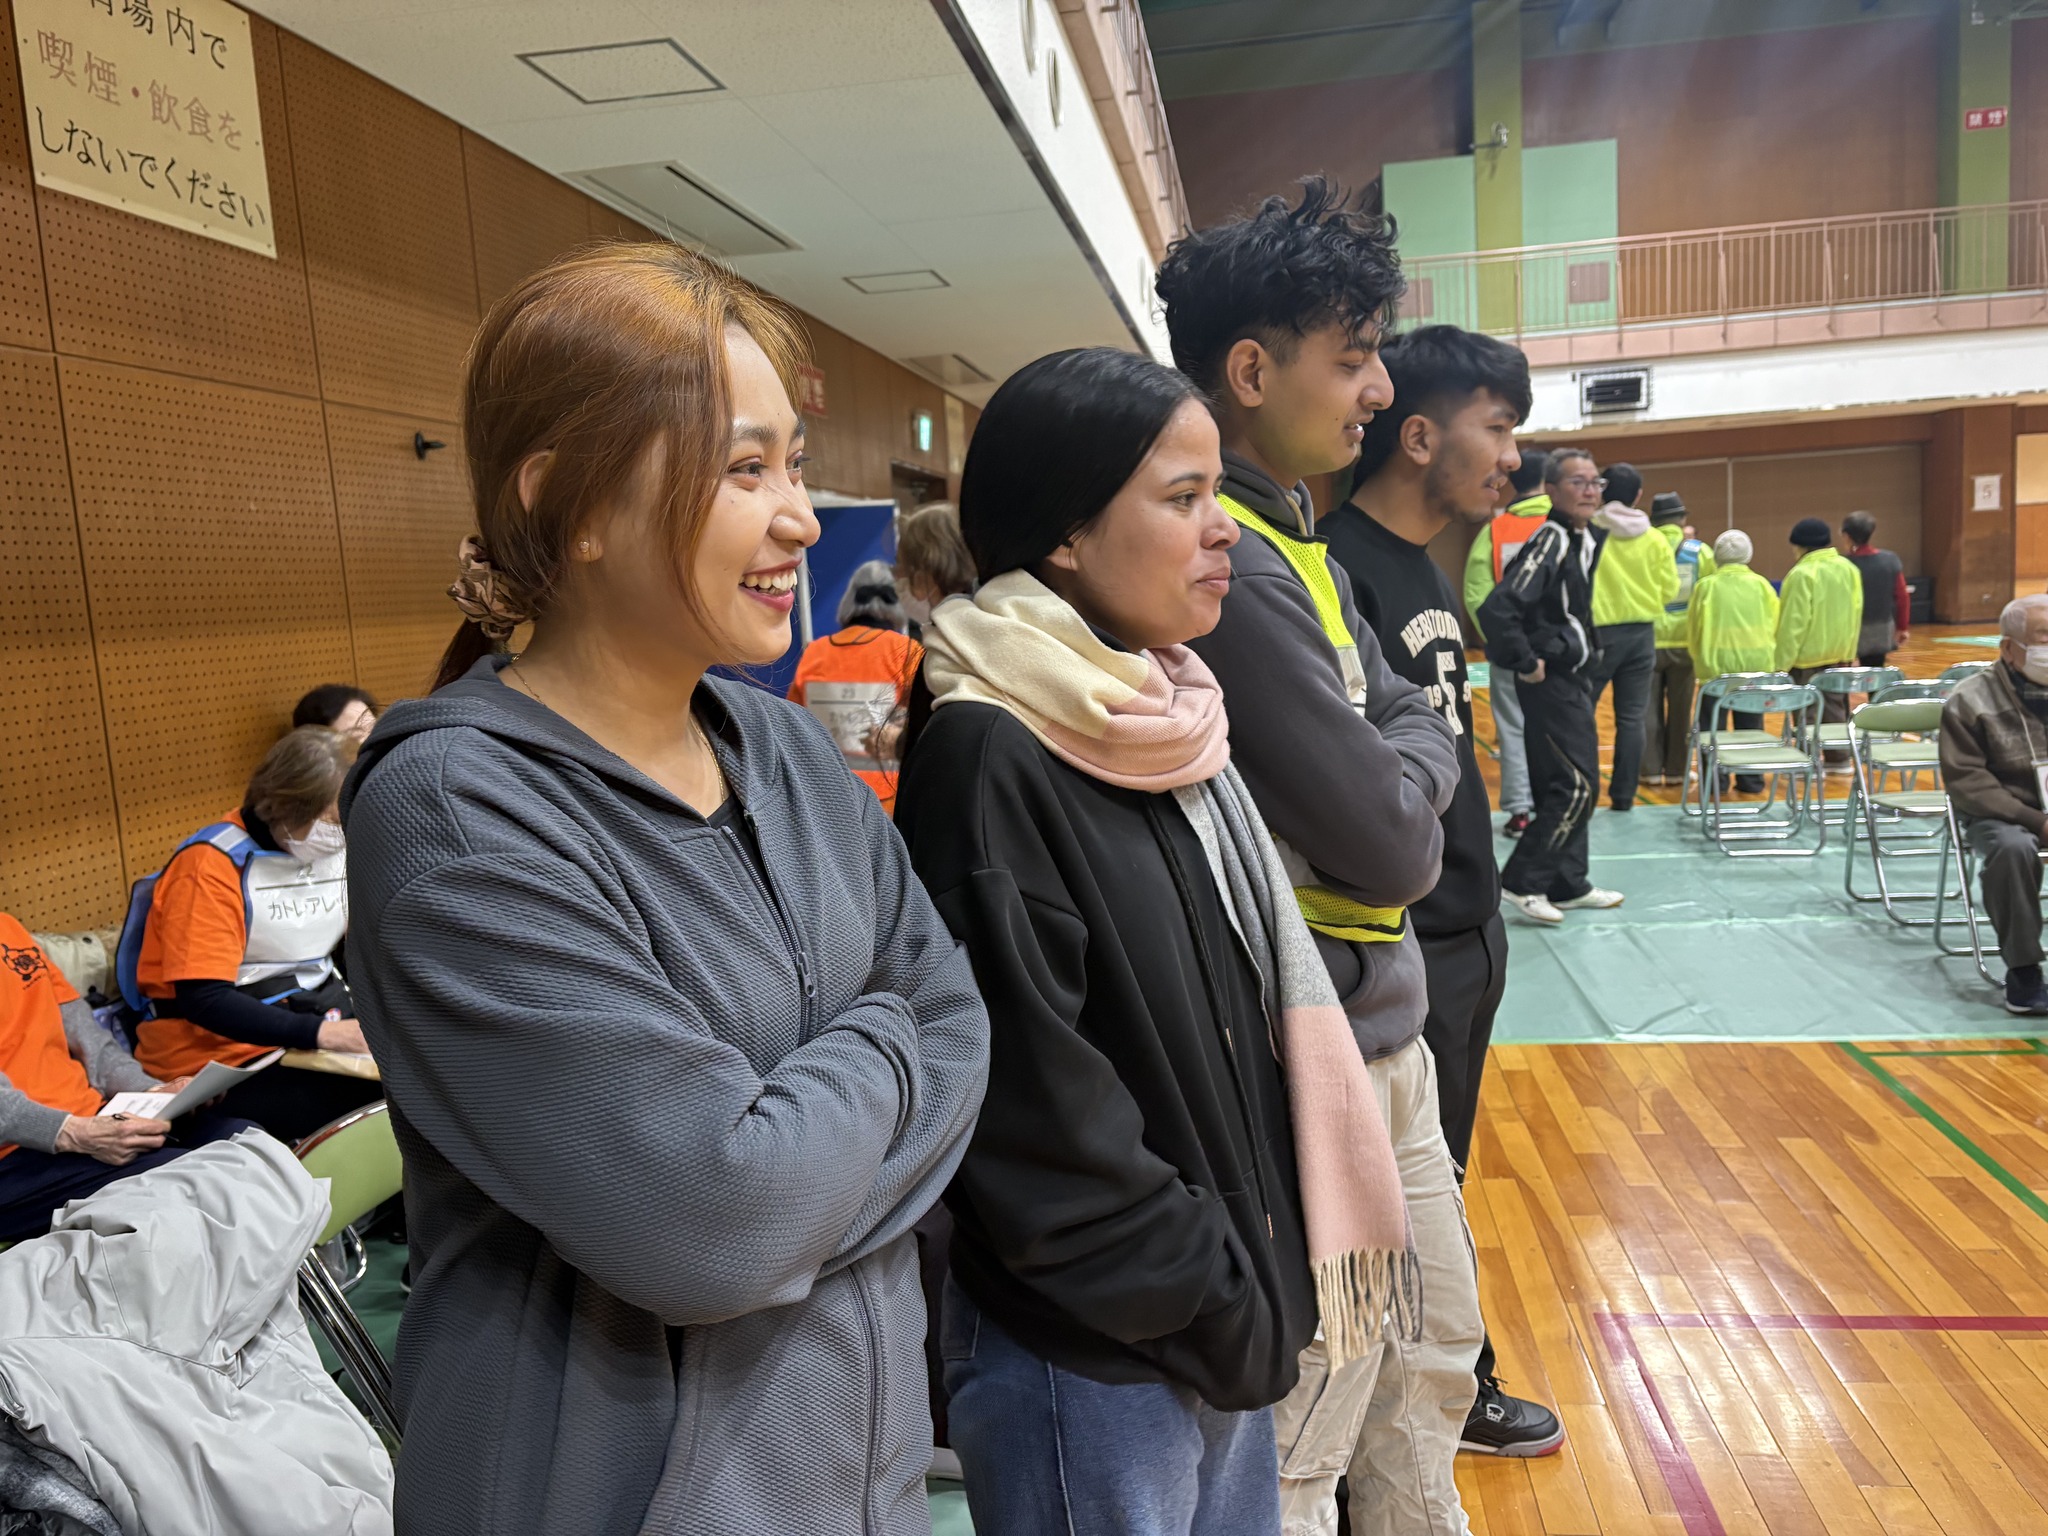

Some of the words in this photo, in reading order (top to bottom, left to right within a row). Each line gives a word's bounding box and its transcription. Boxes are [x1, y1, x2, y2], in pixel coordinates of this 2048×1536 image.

[37, 29, 242, 151] 喫煙・飲食を
[36, 106, 266, 228] しないでください
